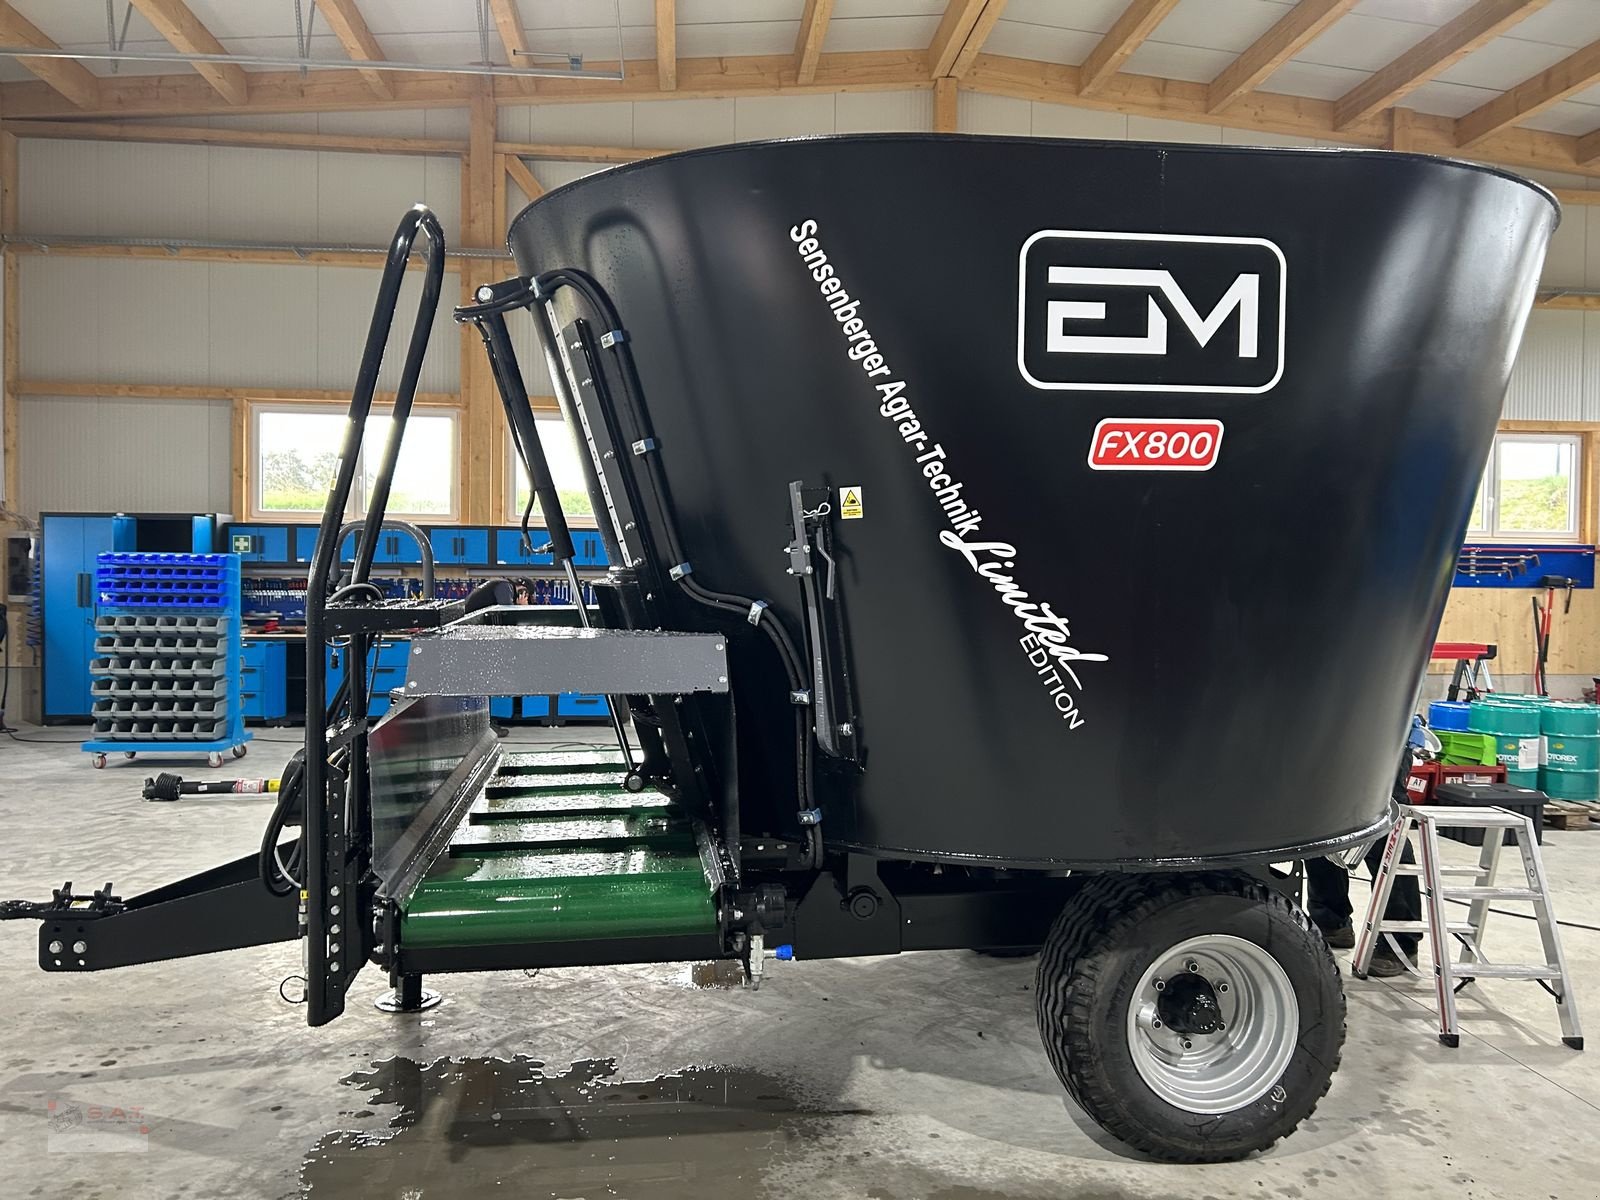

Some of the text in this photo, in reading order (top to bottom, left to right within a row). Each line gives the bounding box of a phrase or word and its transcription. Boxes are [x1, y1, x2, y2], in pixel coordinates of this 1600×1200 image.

[1047, 266, 1259, 358] EM
[790, 219, 983, 538] Sensenberger Agrar-Technik
[1097, 431, 1213, 459] FX800
[940, 530, 1109, 691] Limited
[1019, 632, 1085, 730] EDITION
[1496, 754, 1519, 762] OTOR
[1547, 753, 1578, 763] OTOREX
